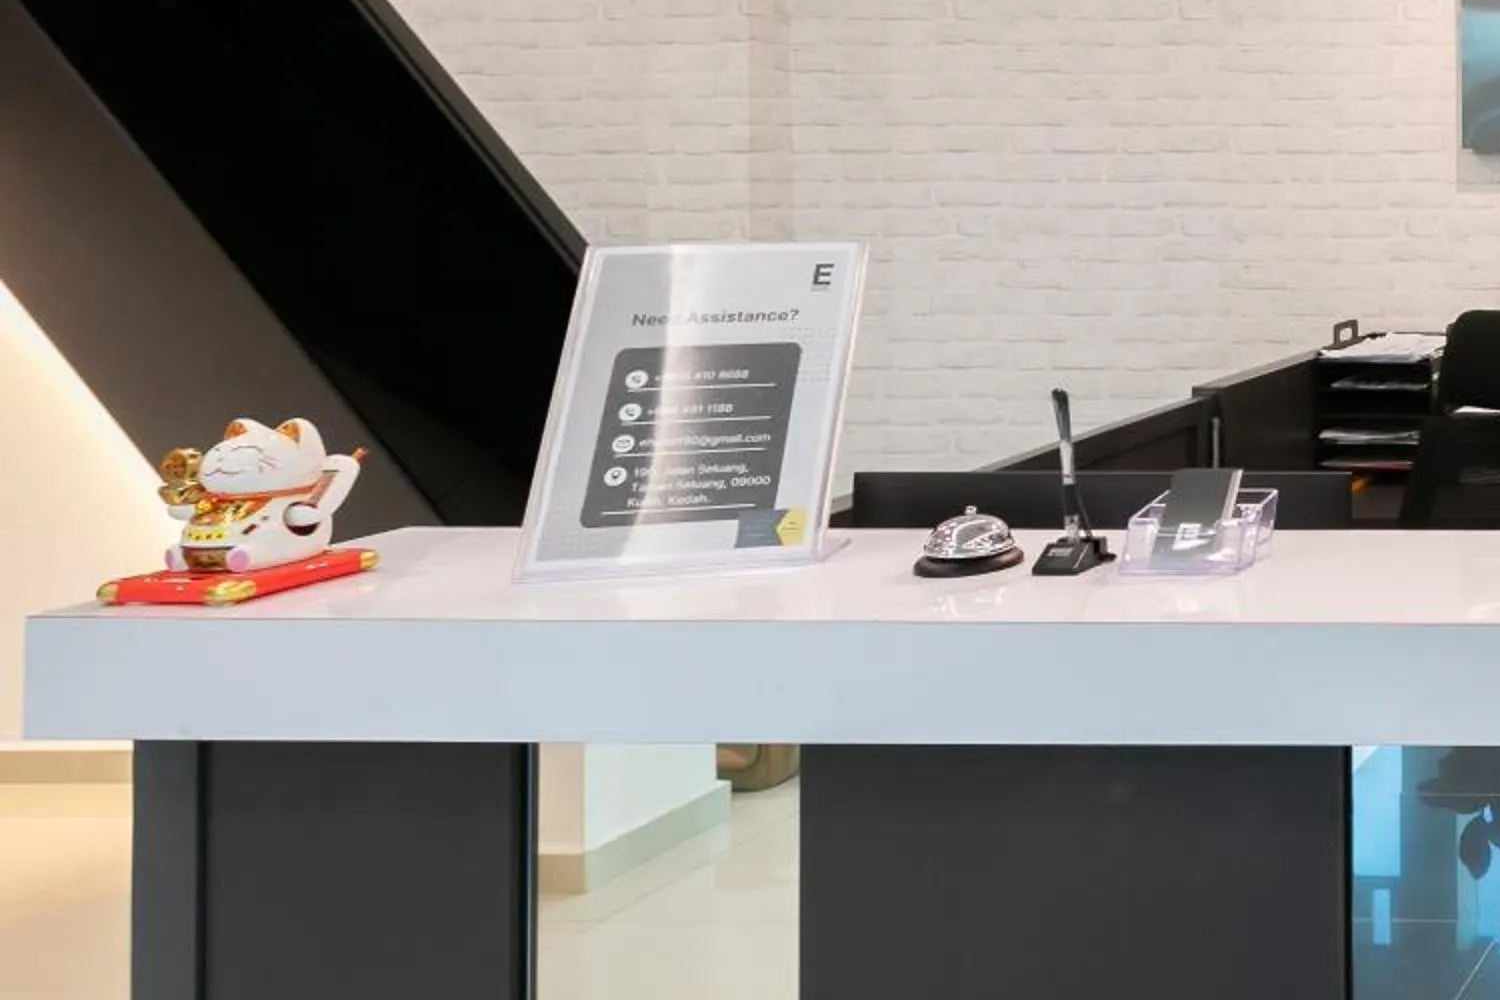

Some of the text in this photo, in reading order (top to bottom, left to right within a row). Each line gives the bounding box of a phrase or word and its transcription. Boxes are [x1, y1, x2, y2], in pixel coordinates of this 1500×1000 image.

[812, 263, 835, 286] E
[631, 308, 800, 327] Nee Assistance?
